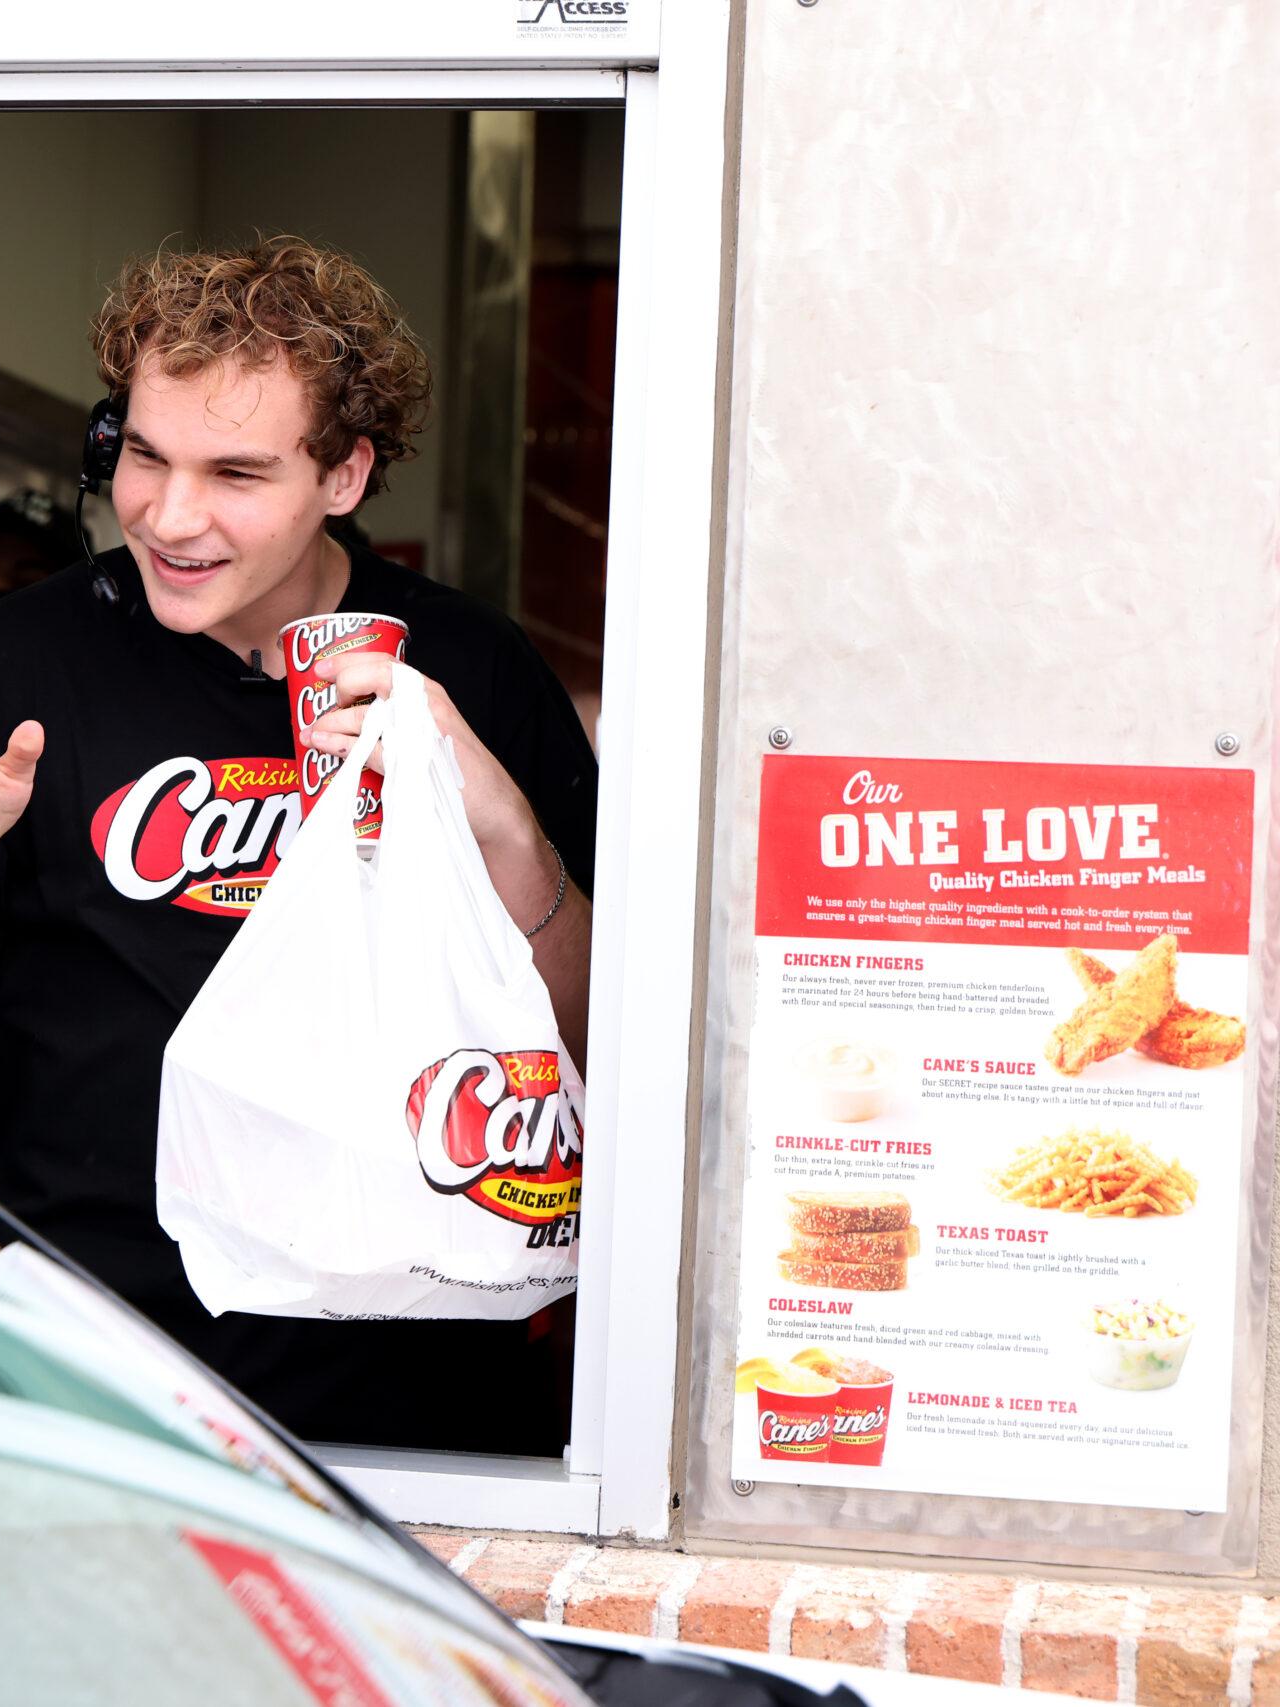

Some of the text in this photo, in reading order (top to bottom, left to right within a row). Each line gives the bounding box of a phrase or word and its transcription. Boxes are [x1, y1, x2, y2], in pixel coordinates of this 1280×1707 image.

[217, 762, 299, 792] Raisin
[842, 769, 903, 806] Our
[104, 756, 302, 900] Can
[820, 809, 959, 868] ONE
[930, 866, 1206, 892] Quality Chicken Finger Meals
[212, 884, 262, 902] CHIC
[807, 895, 1192, 922] We use only the highest quality ingredients with a cook-to-order system that
[806, 911, 1192, 935] ensures a great-tasting chicken finger meal served hot and fresh every time.
[784, 952, 924, 971] CHICKEN FINGERS
[799, 975, 826, 985] always
[927, 980, 963, 990] premium
[966, 982, 996, 990] chicken
[797, 986, 837, 996] marinated
[840, 988, 851, 996] for
[854, 988, 863, 997] 24
[866, 989, 889, 998] hours
[891, 990, 916, 999] before
[918, 991, 940, 1001] being
[1000, 994, 1015, 1002] and
[1017, 995, 1049, 1004] breaded
[782, 998, 798, 1006] with
[801, 998, 820, 1007] flour
[822, 999, 836, 1007] and
[839, 1000, 866, 1010] special
[917, 1003, 934, 1011] then
[937, 1003, 955, 1012] fried
[958, 1004, 965, 1012] to
[999, 1006, 1026, 1015] golden
[923, 1058, 1036, 1076] CANE'S SAUCE
[776, 1136, 932, 1156] CRINKLE-CUT FRIES
[774, 1154, 789, 1163] Our
[811, 1156, 831, 1165] extra
[774, 1166, 785, 1174] cut
[788, 1167, 806, 1175] from
[809, 1168, 831, 1178] grade
[844, 1169, 879, 1180] premium
[936, 1225, 1049, 1244] TEXAS TOAST
[768, 1298, 853, 1315] COLESLAW
[908, 1391, 1078, 1414] LEMONADE & ICED TEA
[759, 1410, 830, 1446] Cane's
